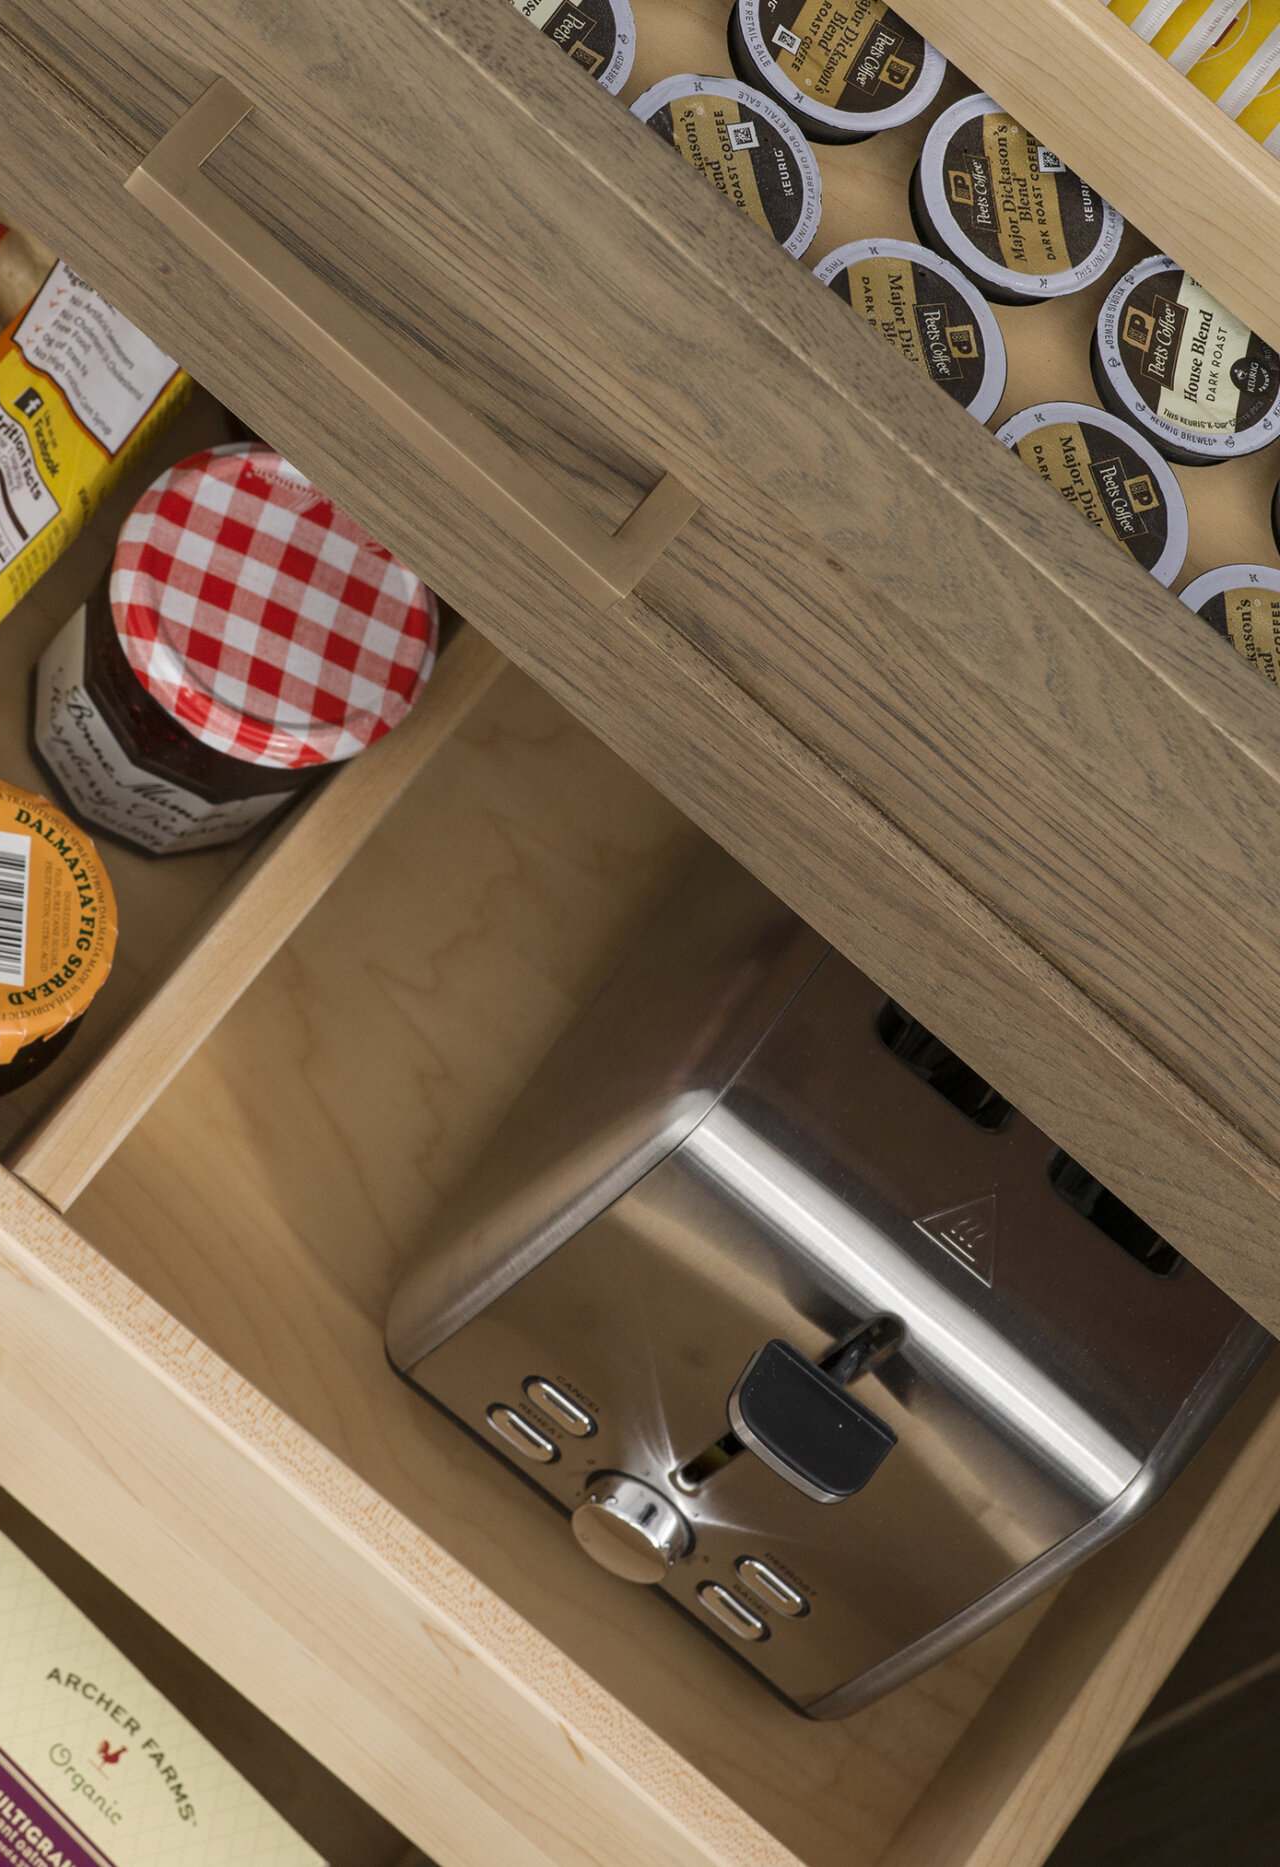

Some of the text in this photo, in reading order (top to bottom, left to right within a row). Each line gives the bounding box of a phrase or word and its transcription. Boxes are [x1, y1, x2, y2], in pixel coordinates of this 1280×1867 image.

[744, 10, 772, 69] RETAIL SALE
[791, 2, 834, 73] ROAST COFFEE
[814, 28, 861, 95] Dickason's
[856, 31, 897, 88] Peet's Coffee
[737, 90, 762, 108] SALE
[763, 105, 790, 134] RETAIL
[714, 110, 734, 161] COFFEE
[789, 134, 803, 154] FOR
[726, 166, 747, 208] ROAST
[773, 148, 794, 197] KEURIG
[971, 159, 992, 225] Peet's Coffee
[992, 124, 1029, 263] Major Dickason's
[795, 221, 810, 243] UNIT
[805, 201, 816, 221] NOT
[1031, 186, 1049, 229] ROAST
[1039, 229, 1058, 262] DARK
[1073, 229, 1115, 281] THIS UNIT NOT
[861, 275, 877, 314] DARK
[886, 272, 908, 326] Major
[923, 307, 951, 376] Peet's Coffee
[1147, 346, 1169, 380] Peet's
[1183, 308, 1214, 404] House Blend
[1205, 325, 1229, 403] DARK ROAST
[1246, 361, 1260, 394] KEURIG
[21, 454, 43, 501] Facts
[1033, 445, 1053, 482] DARK
[1059, 435, 1085, 489] Major
[1099, 464, 1136, 534] Peet's Coffee
[65, 684, 123, 787] Bonne
[70, 835, 95, 874] SPREAD
[75, 915, 96, 951] FIG
[93, 904, 108, 956] DALMATIA
[7, 953, 84, 1006] SPREAD
[81, 955, 101, 984] MADE
[555, 1374, 602, 1415] CANCEL
[44, 1666, 197, 1823] ARCHER FARMS
[48, 1742, 124, 1827] Organic
